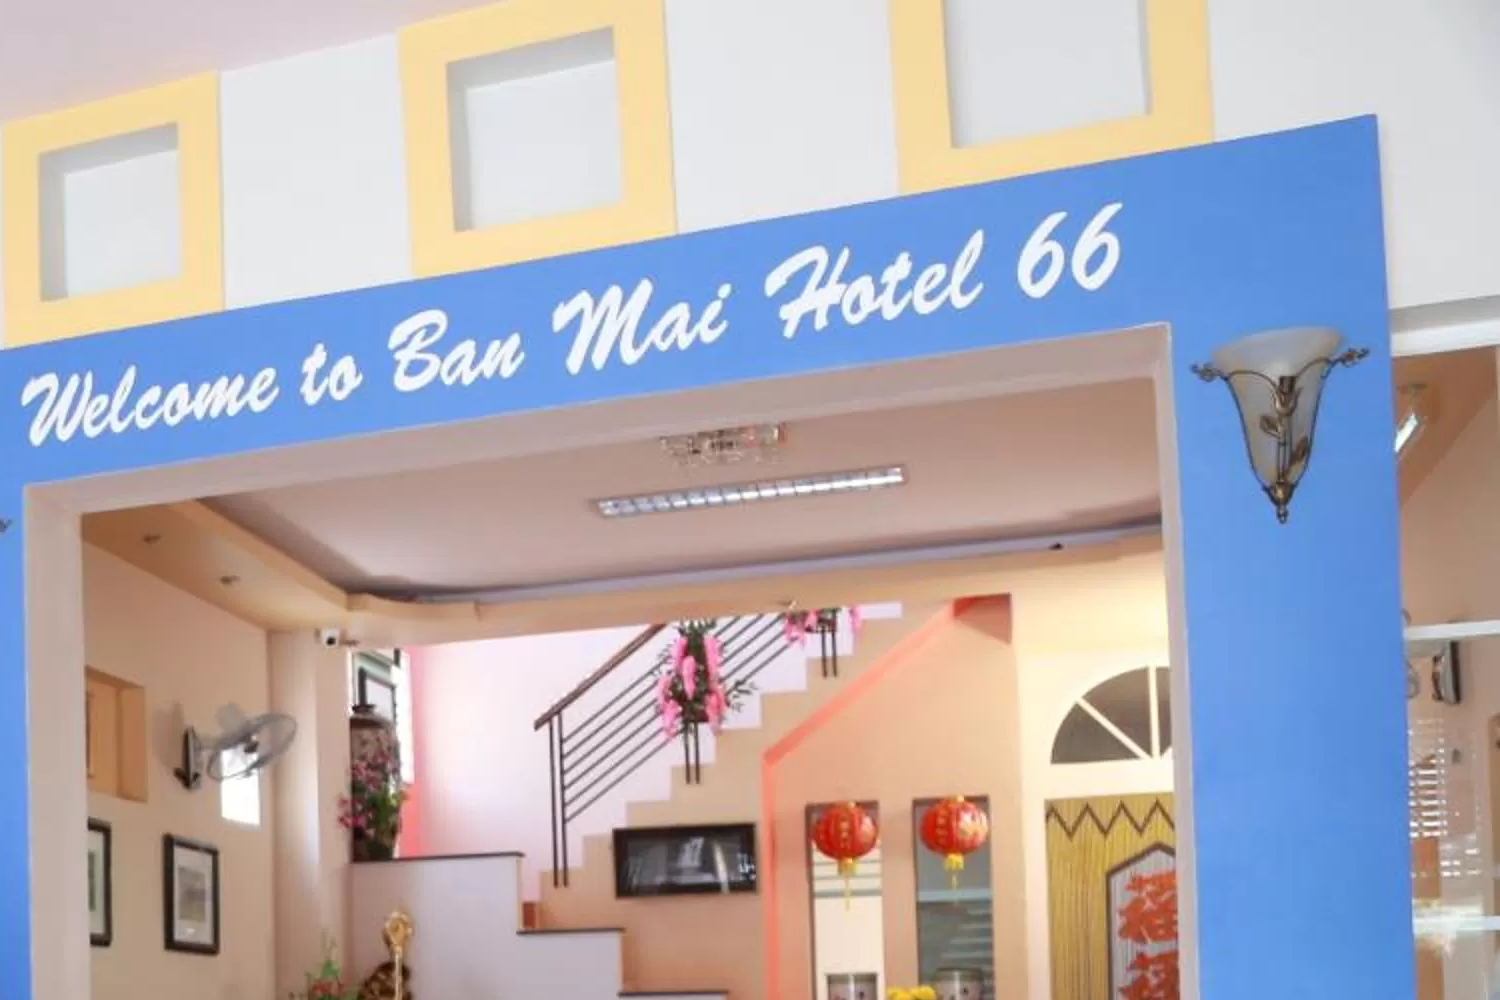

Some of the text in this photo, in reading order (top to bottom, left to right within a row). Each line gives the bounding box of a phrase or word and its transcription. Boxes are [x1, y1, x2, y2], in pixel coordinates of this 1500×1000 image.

[21, 202, 1123, 447] Welcome to Ban Mai Hotel 66
